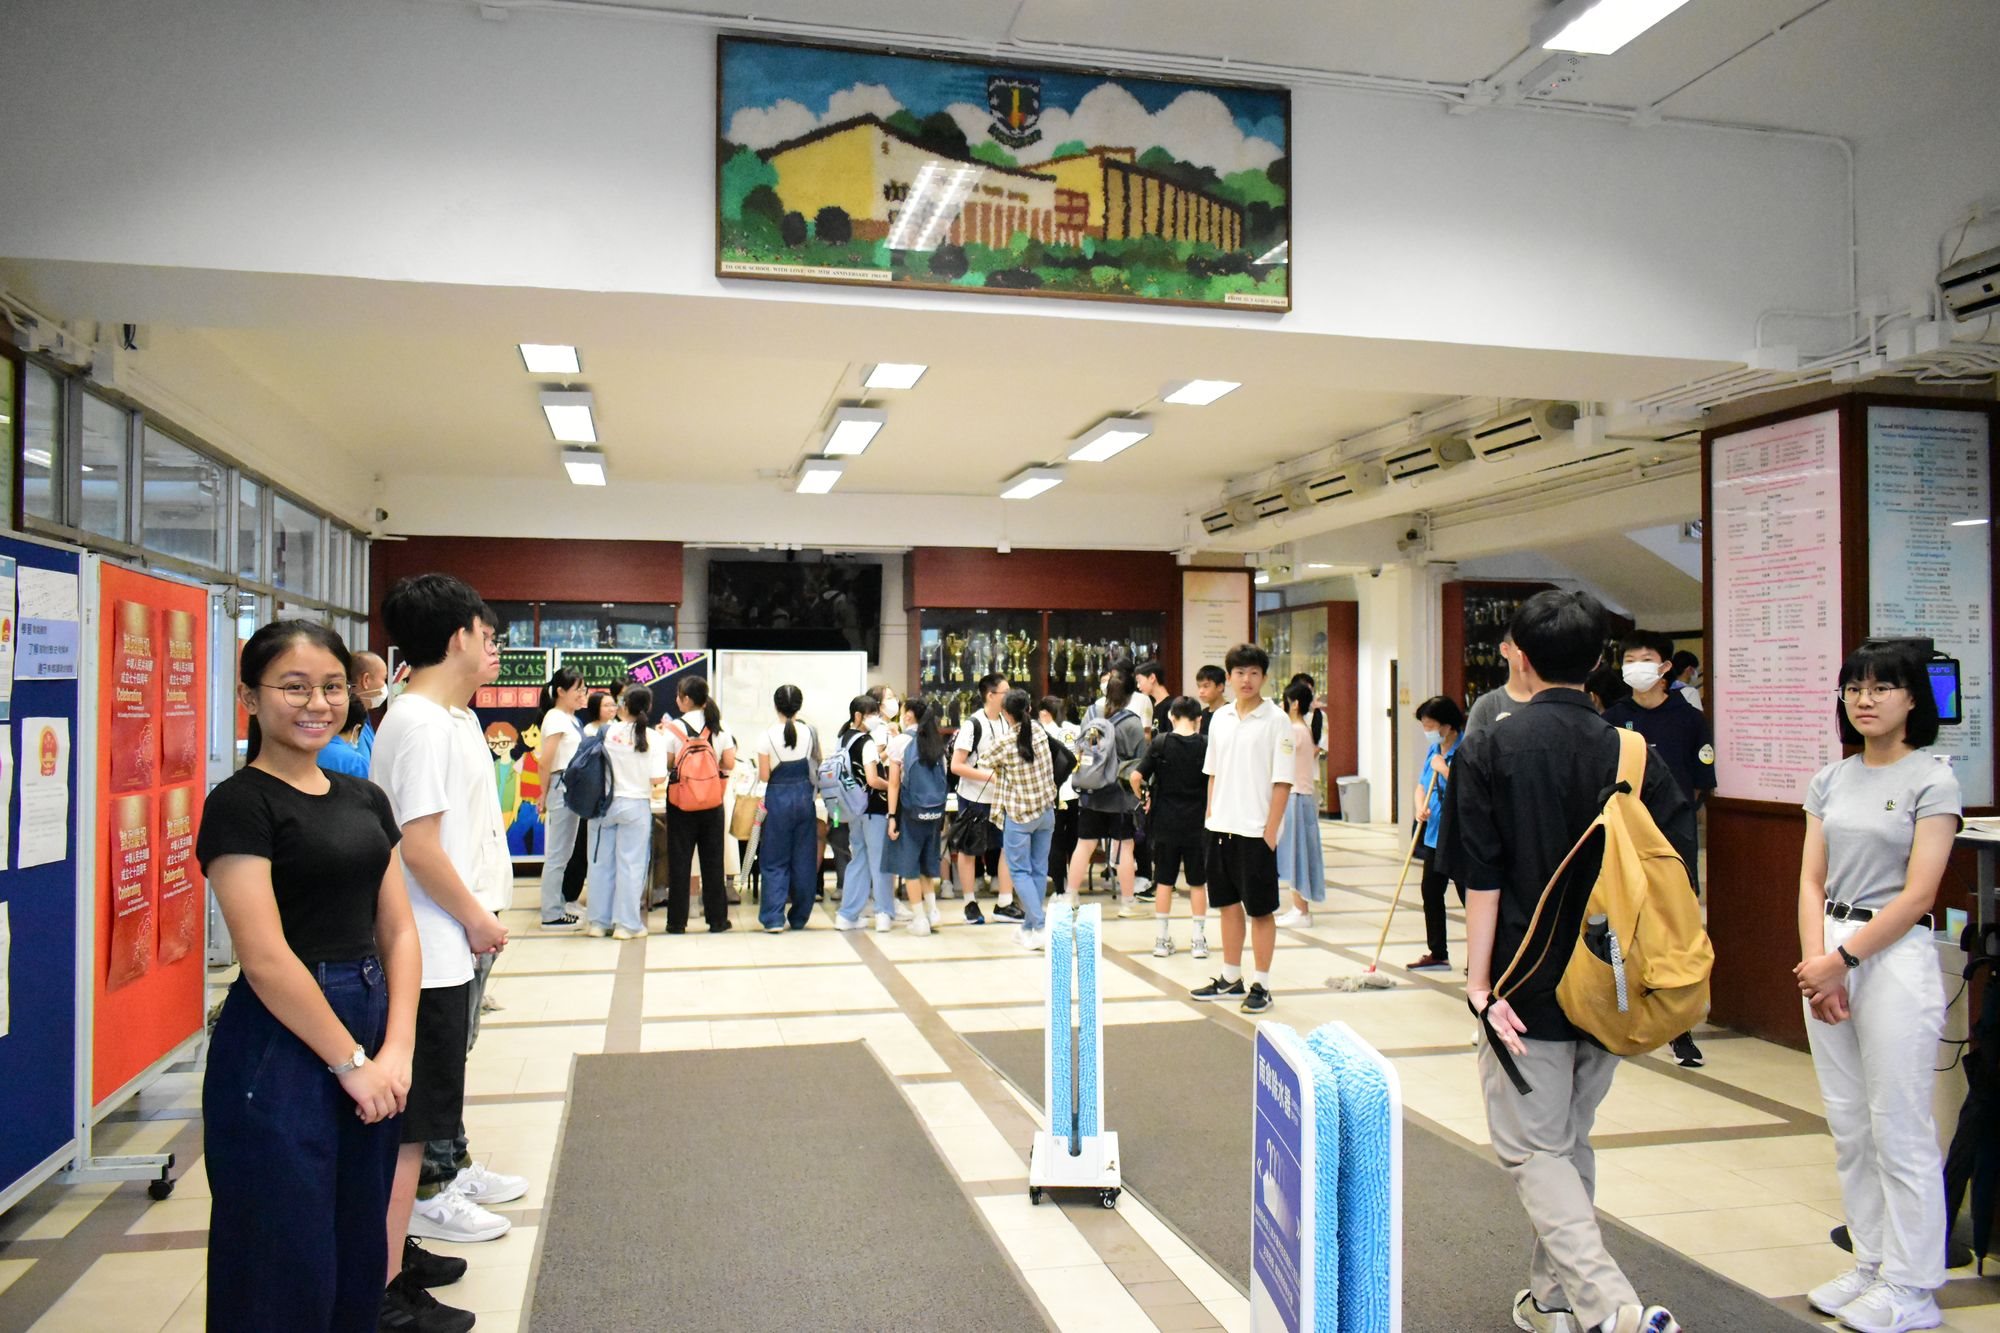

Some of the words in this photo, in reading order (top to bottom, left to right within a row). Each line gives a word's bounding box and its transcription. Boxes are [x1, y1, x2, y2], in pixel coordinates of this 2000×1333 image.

[595, 665, 623, 677] DAY
[117, 687, 142, 704] Celebrating
[918, 812, 942, 821] adidas
[118, 882, 141, 900] Celebrating
